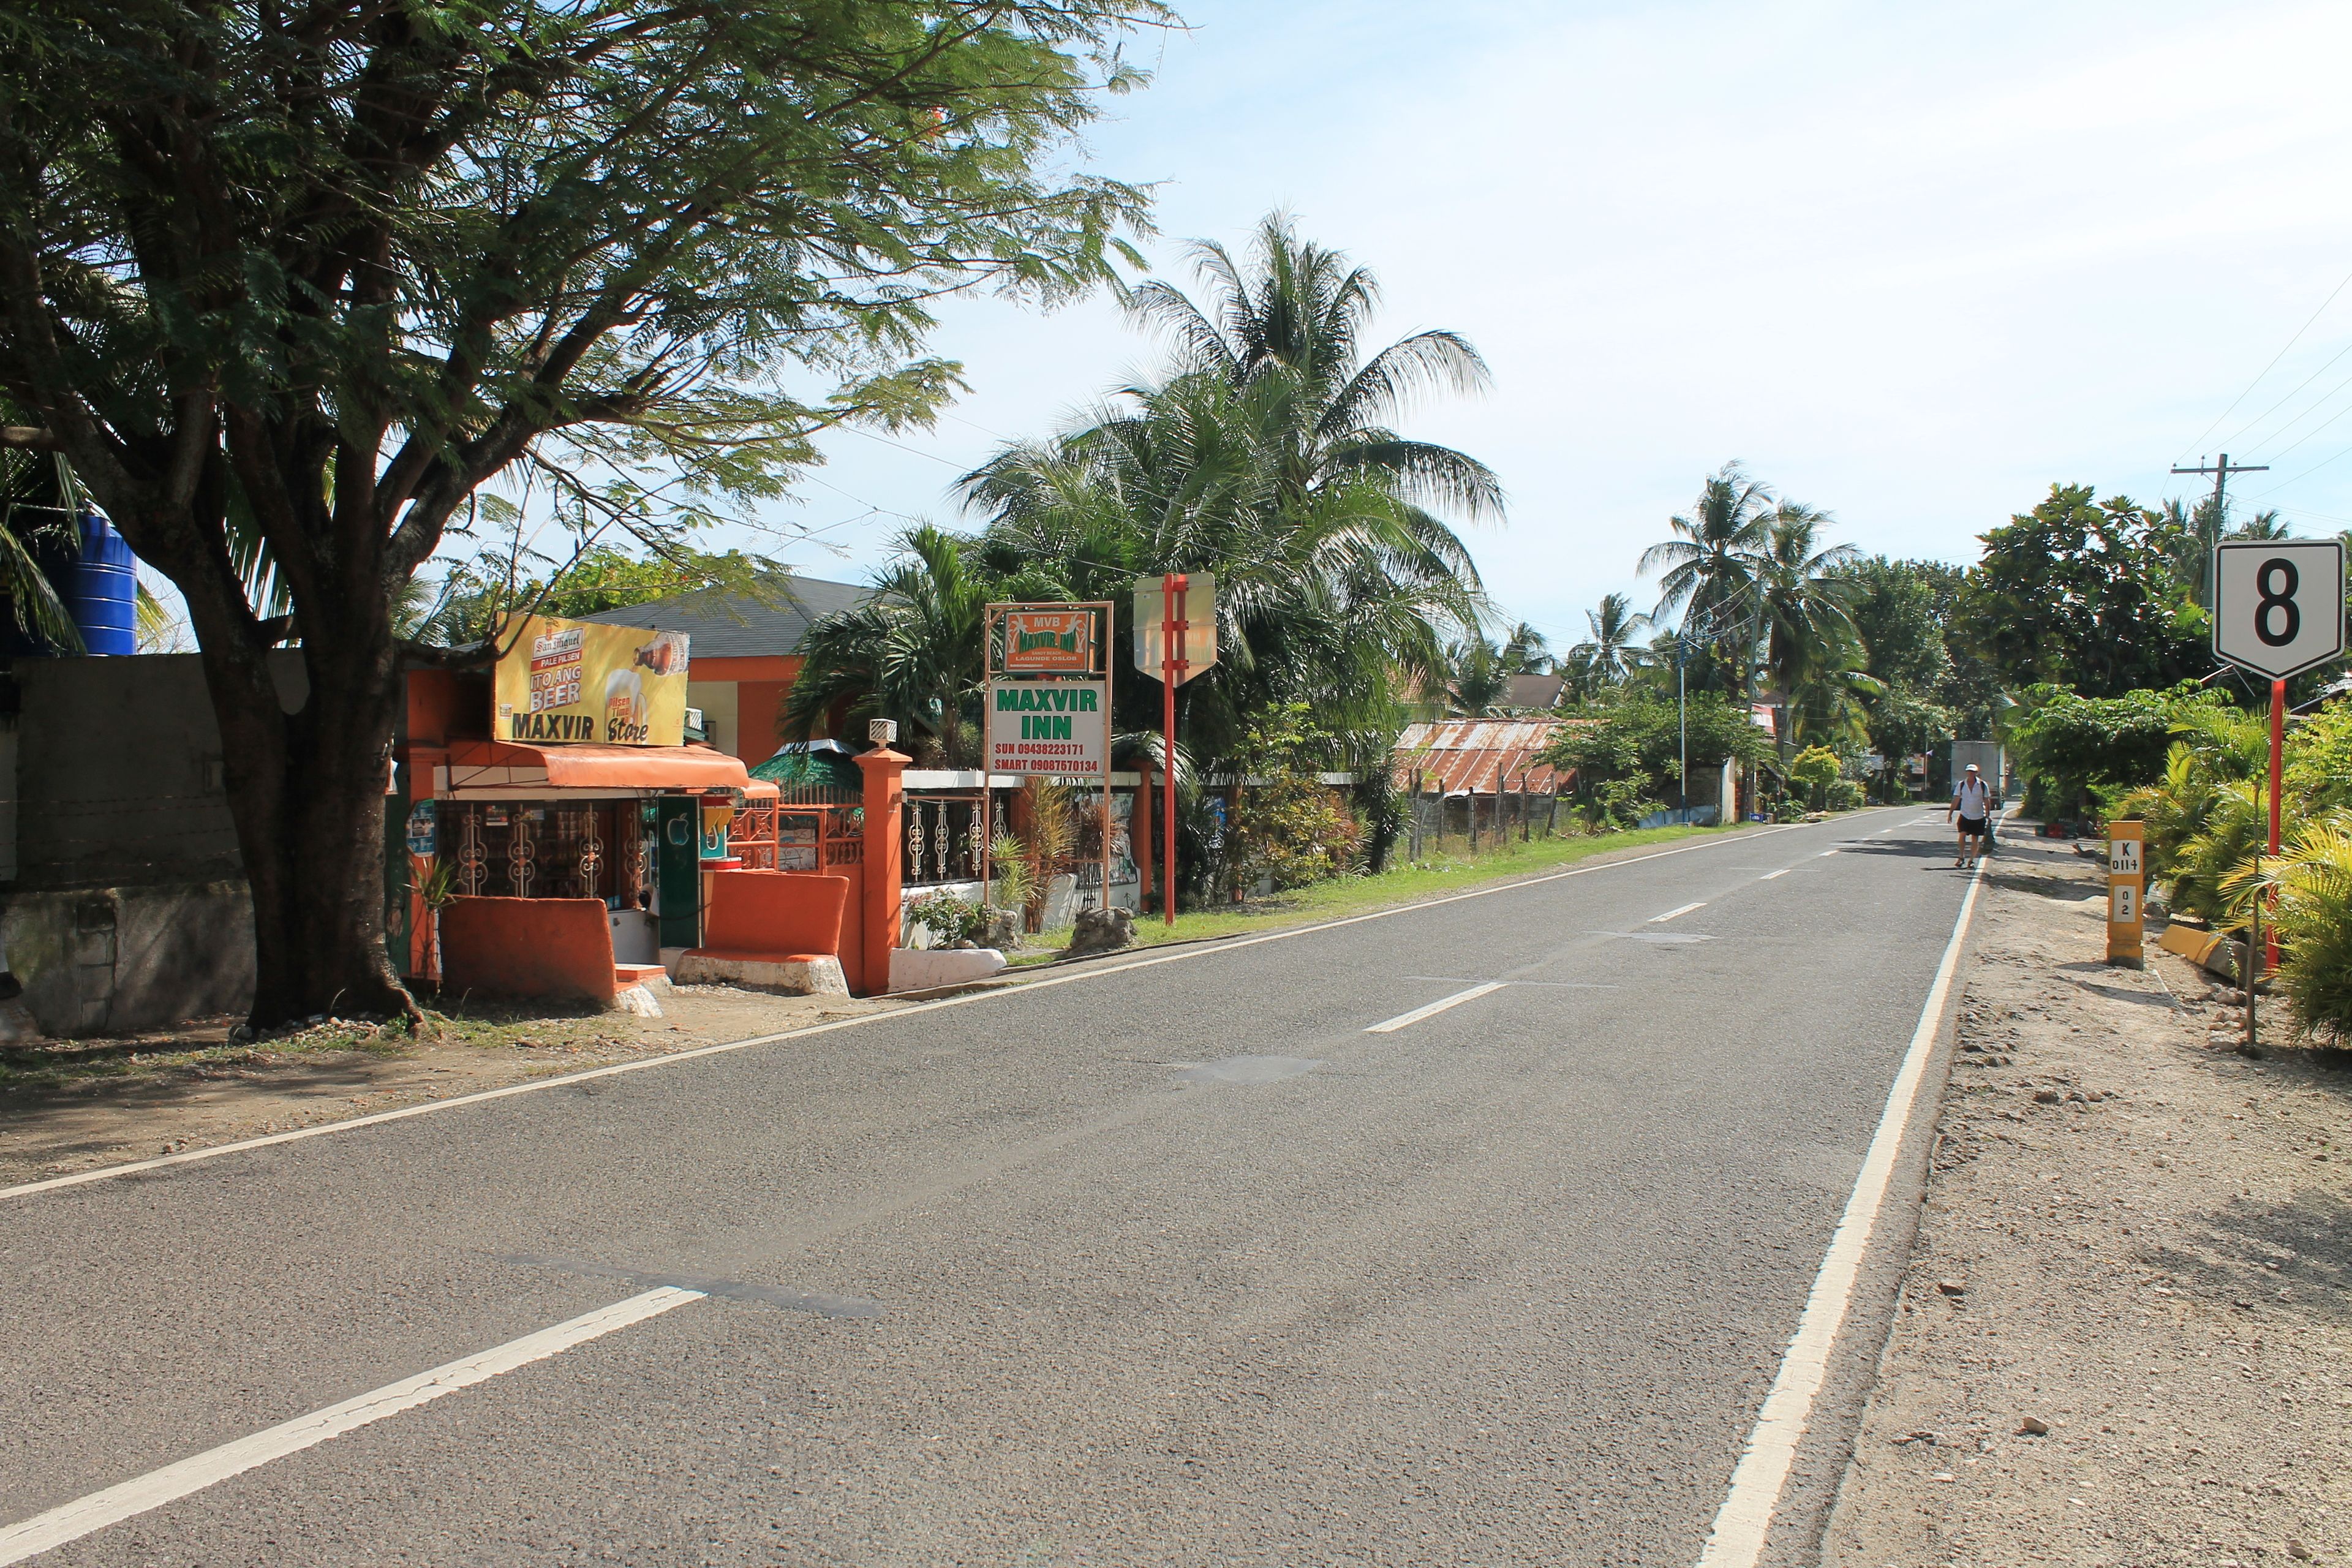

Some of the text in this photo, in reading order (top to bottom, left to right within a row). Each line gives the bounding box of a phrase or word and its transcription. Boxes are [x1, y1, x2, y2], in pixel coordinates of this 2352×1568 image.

[2255, 558, 2300, 647] 8
[1034, 617, 1060, 627] MVB
[537, 634, 579, 652] San Miguel
[1060, 628, 1077, 654] INN
[541, 652, 580, 667] PALE PILSEN
[530, 665, 582, 690] ITO ANG
[530, 682, 581, 714] BEER
[997, 689, 1098, 712] MAXVIR
[513, 713, 648, 742] MAXVIR Store
[1022, 715, 1072, 740] INN
[995, 744, 1084, 755] SUN 09438223171
[995, 760, 1028, 770] SMART
[2122, 843, 2130, 856] K
[2113, 860, 2137, 870] 0114
[2122, 905, 2128, 915] 2
